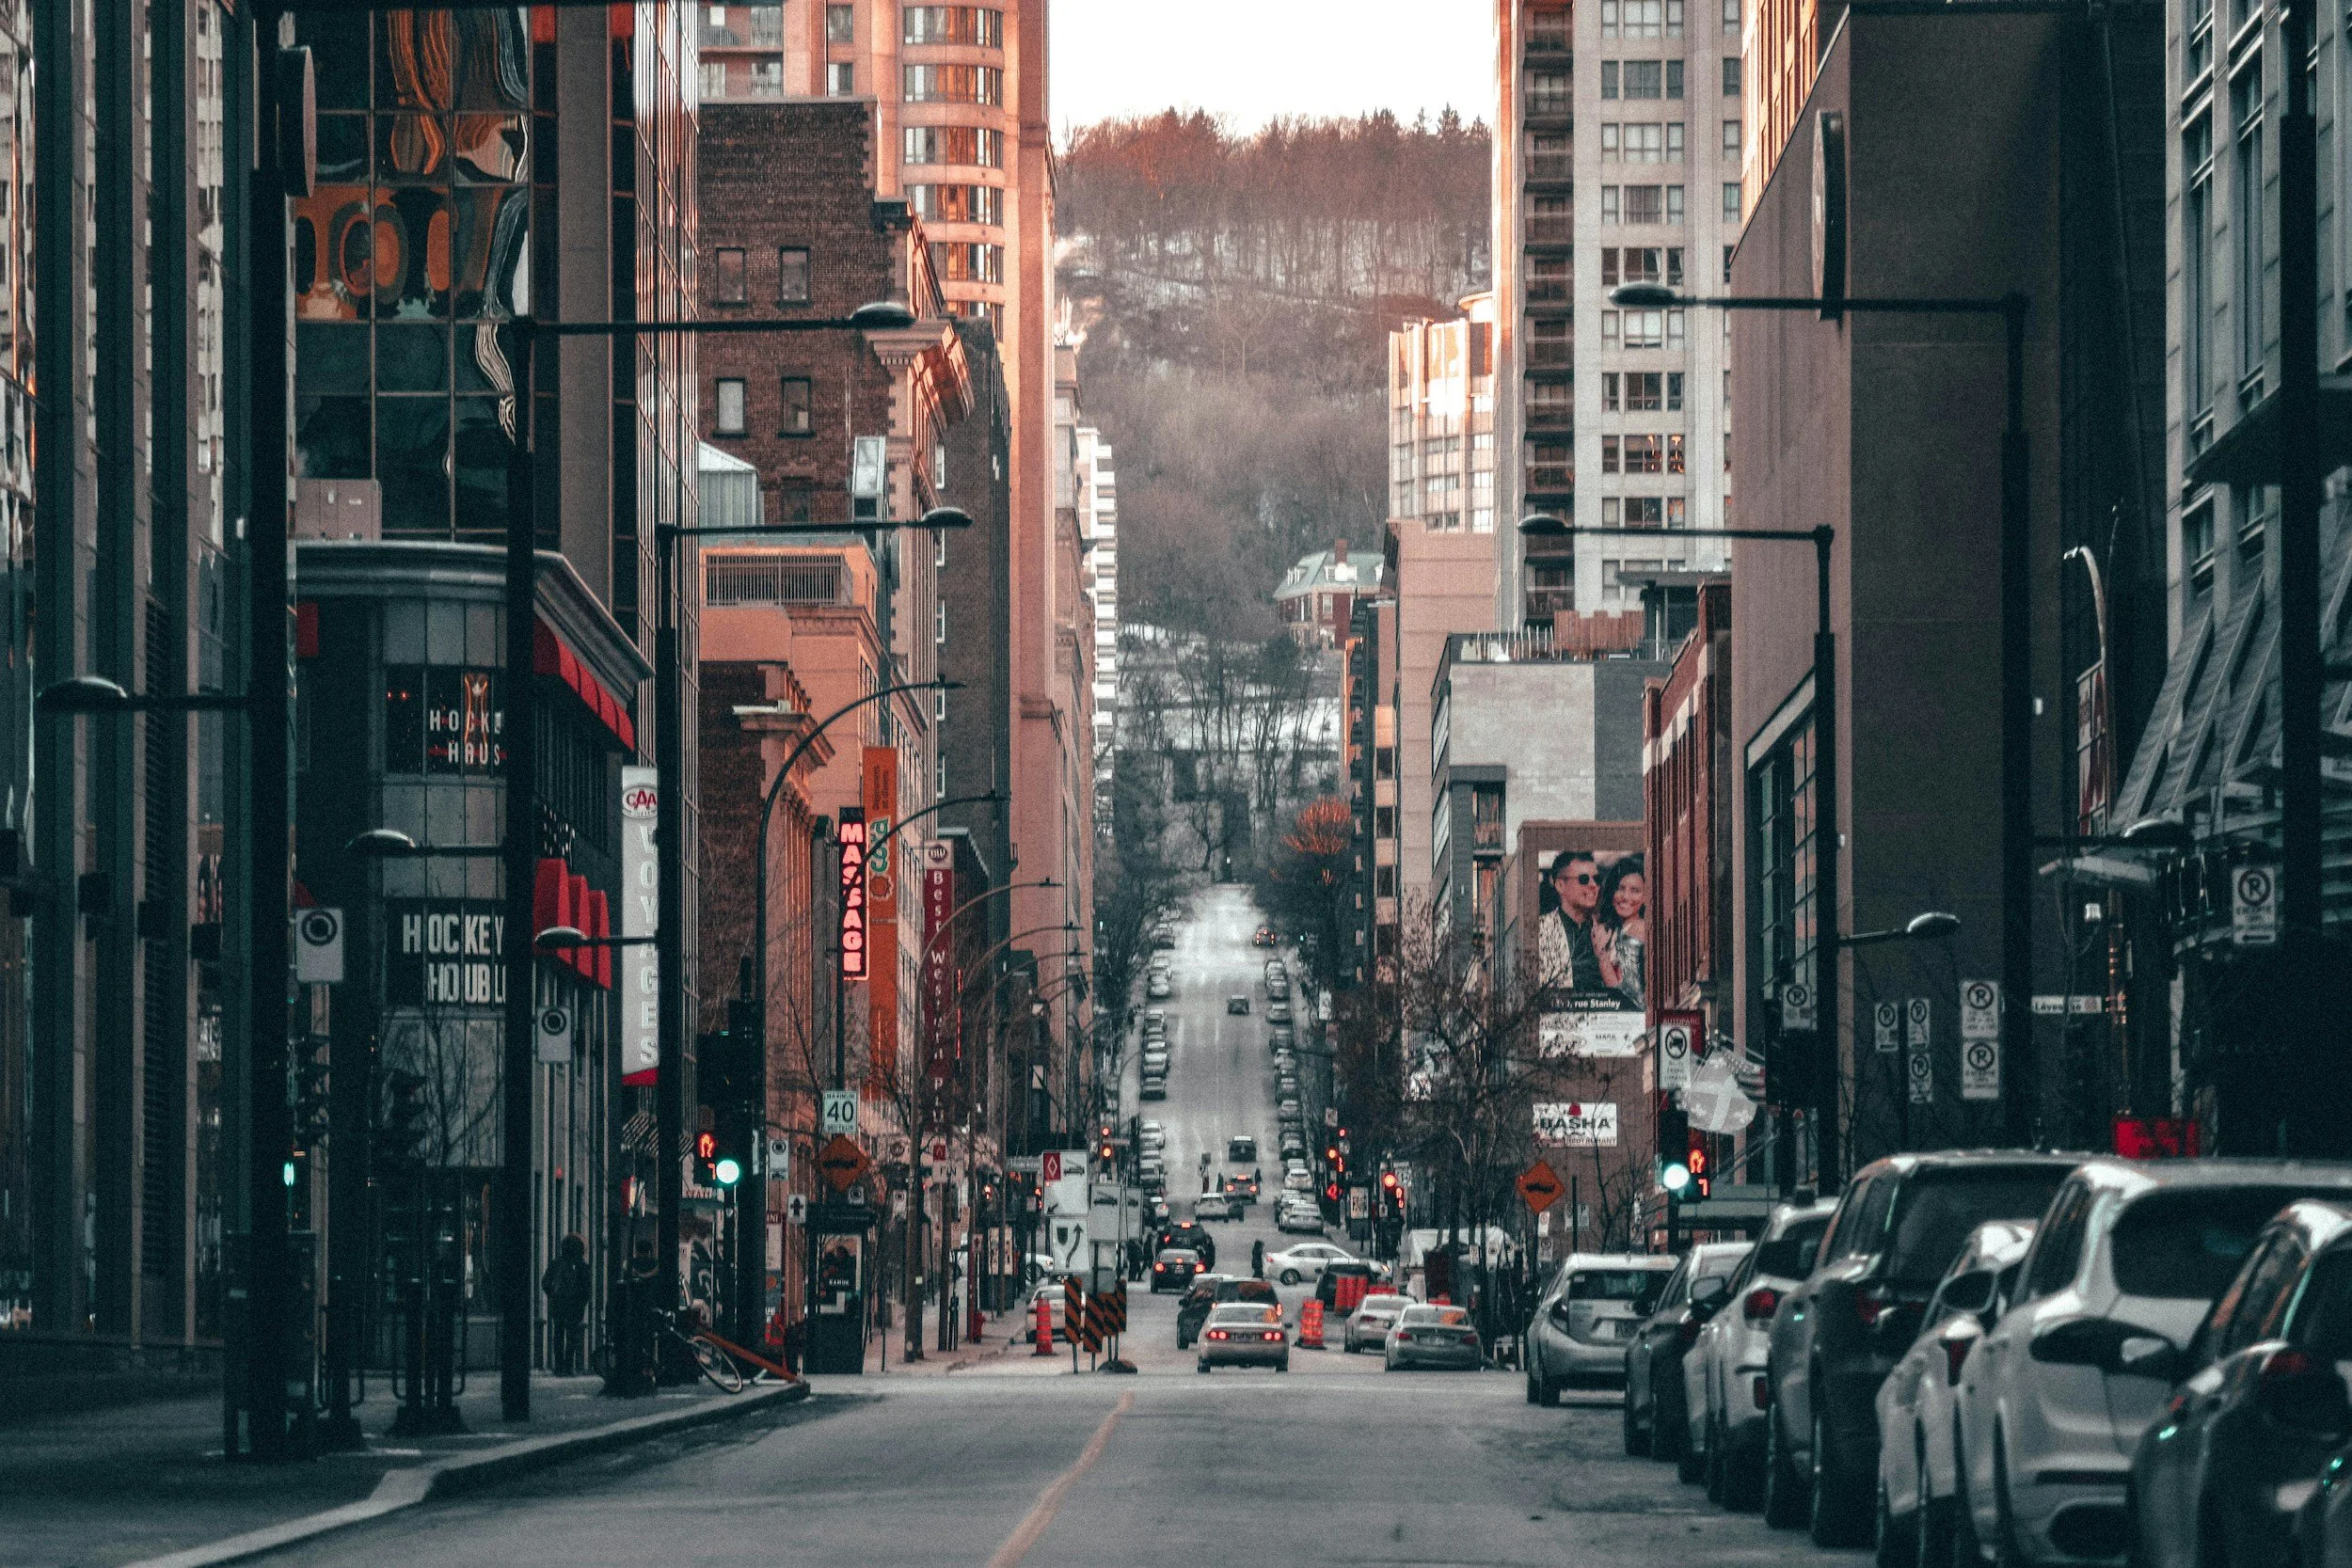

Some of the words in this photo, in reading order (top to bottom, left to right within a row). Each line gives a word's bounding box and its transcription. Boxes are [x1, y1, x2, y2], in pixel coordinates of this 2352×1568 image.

[448, 743, 501, 766] HAUS
[626, 789, 657, 810] CAA
[840, 822, 864, 973] MASSAGE
[932, 870, 944, 933] Best
[403, 912, 505, 956] HOCKEY
[640, 825, 658, 1065] VOYAGES
[1574, 1000, 1589, 1008] rue
[1590, 997, 1621, 1010] Stanley
[827, 1101, 853, 1122] 40
